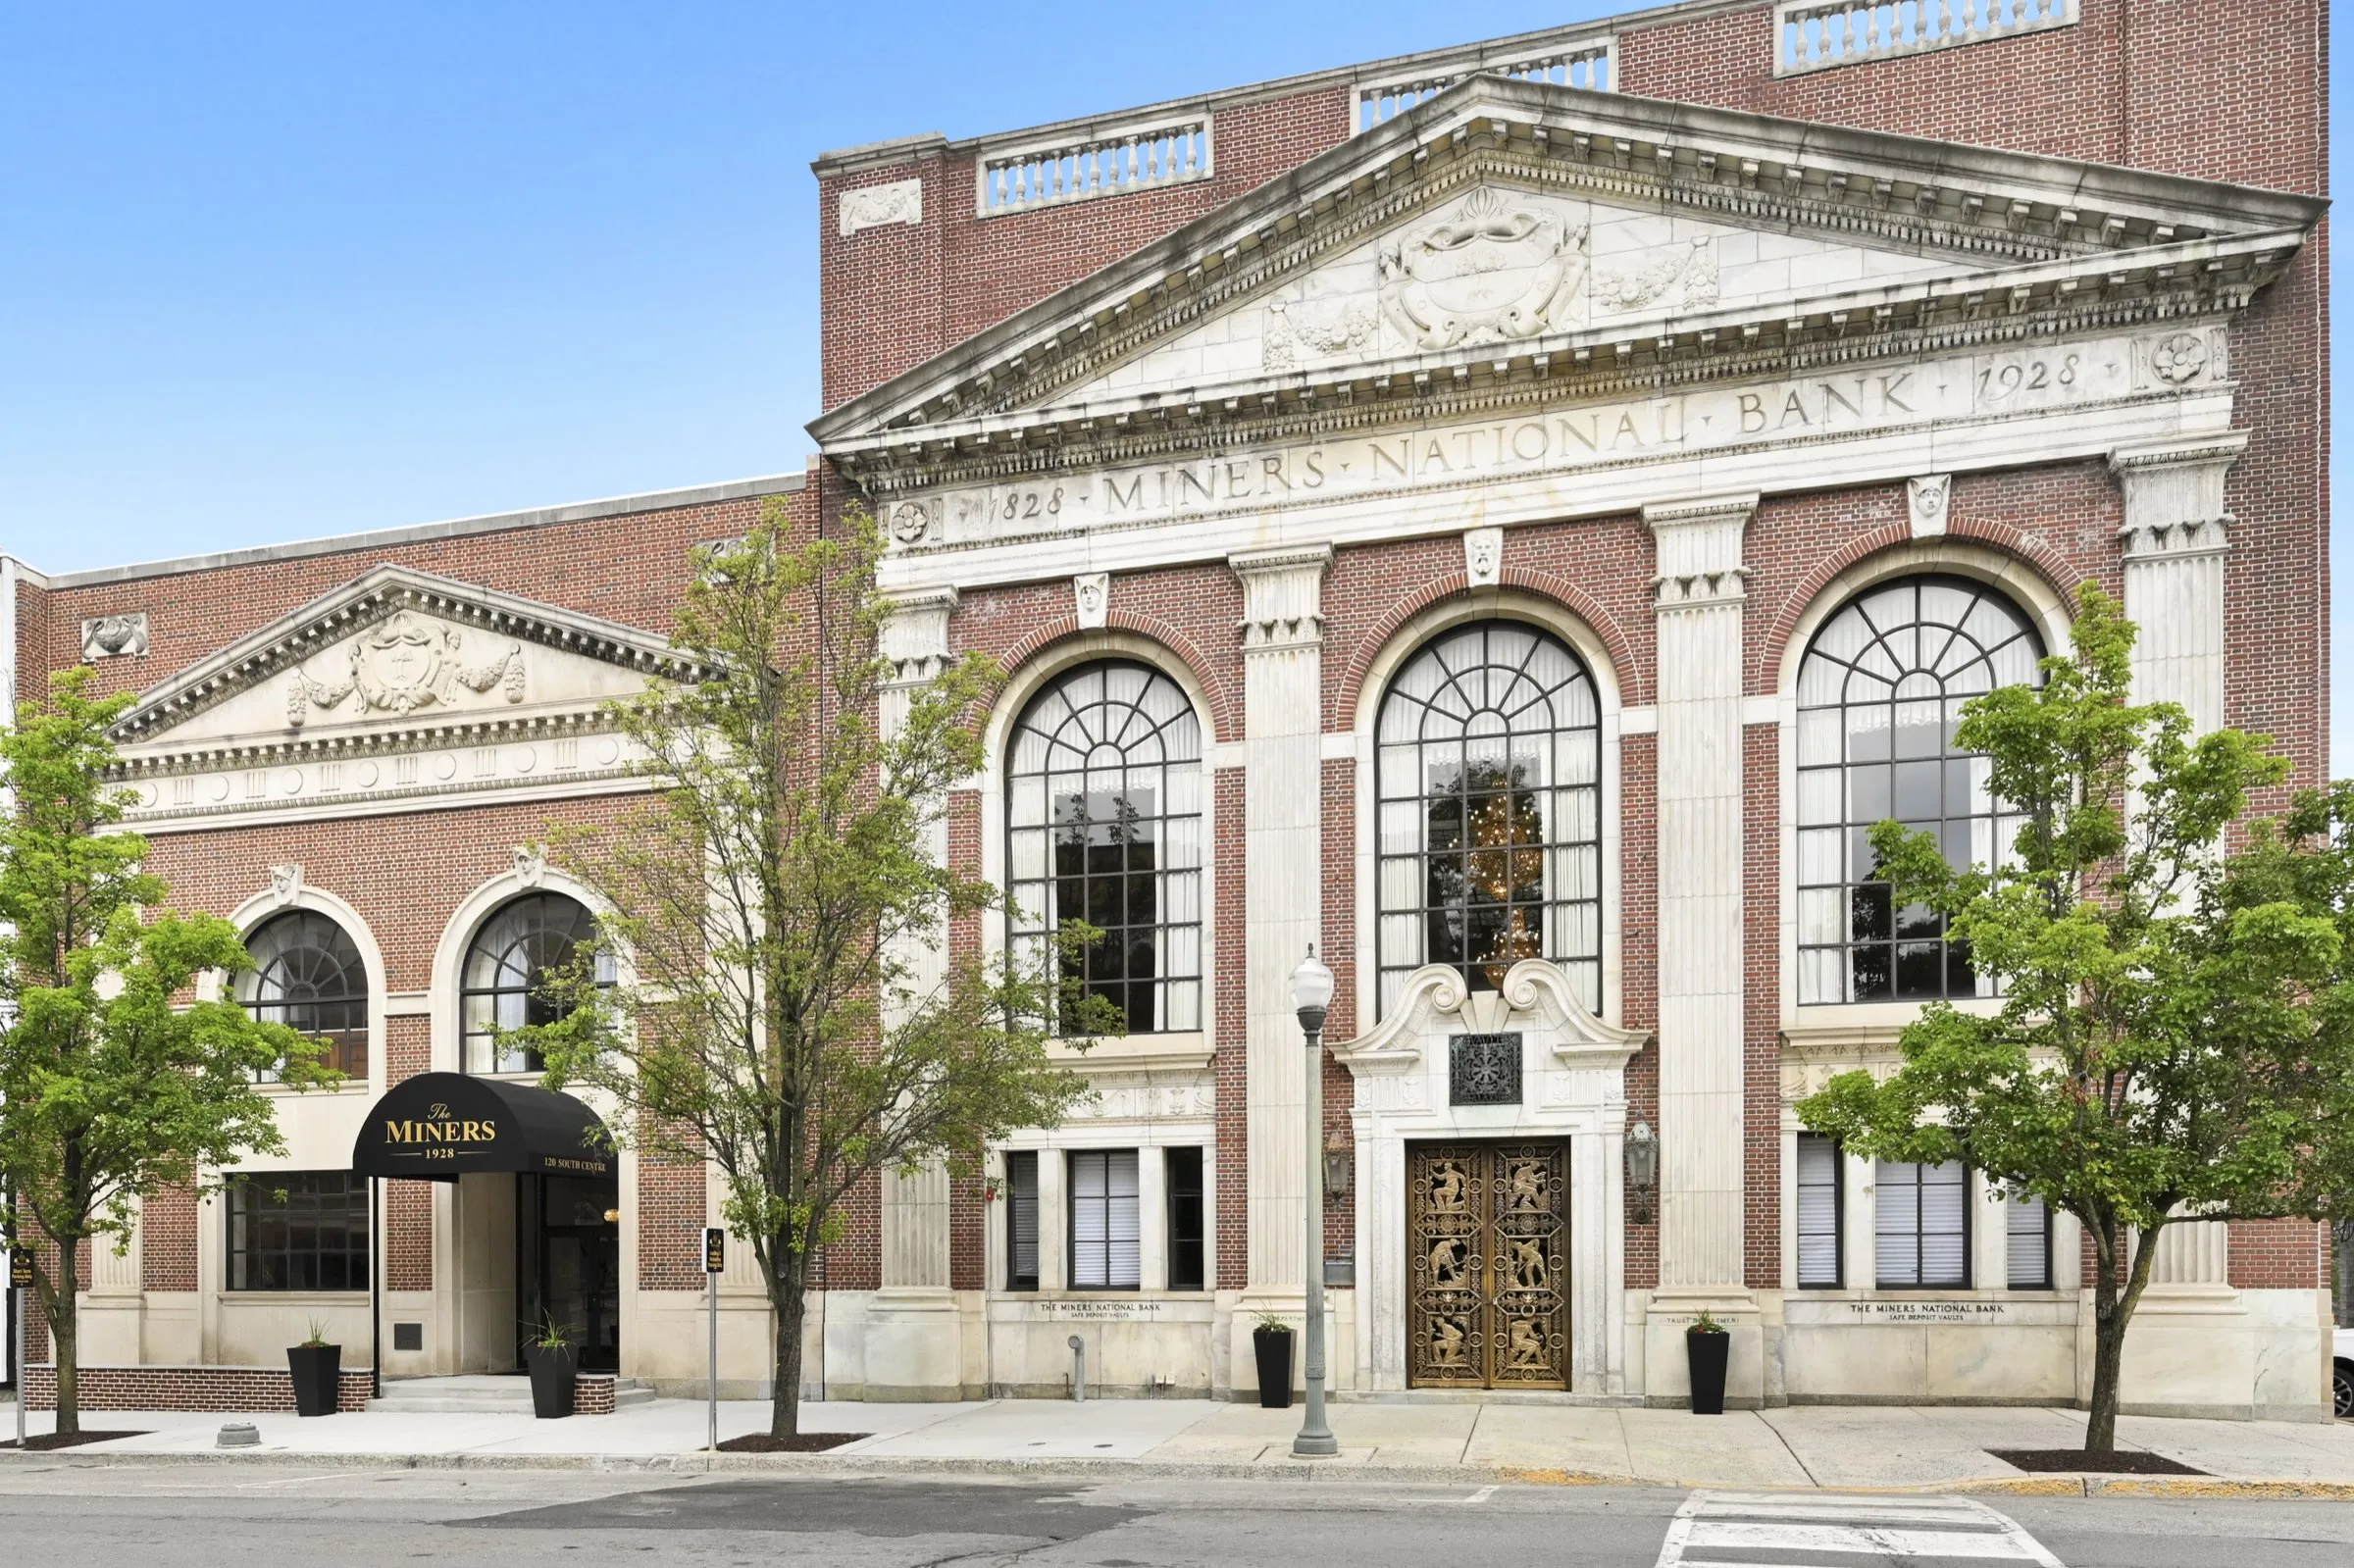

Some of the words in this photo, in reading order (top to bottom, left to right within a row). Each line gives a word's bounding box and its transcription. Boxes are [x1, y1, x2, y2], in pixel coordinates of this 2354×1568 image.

[1101, 451, 1326, 516] MINERS
[1367, 403, 1690, 481] NATIONAL
[1736, 372, 1920, 434] BANK
[1975, 353, 2081, 403] 1928
[427, 1102, 452, 1120] The
[384, 1120, 496, 1144] MINERS
[425, 1147, 454, 1159] 1928
[544, 1157, 556, 1167] 120
[558, 1159, 581, 1169] SOUTH
[1851, 1304, 1870, 1313] THE
[1876, 1304, 1916, 1313] MINERS
[1921, 1304, 1972, 1313] NATIONAL
[1975, 1304, 2005, 1313] BANK
